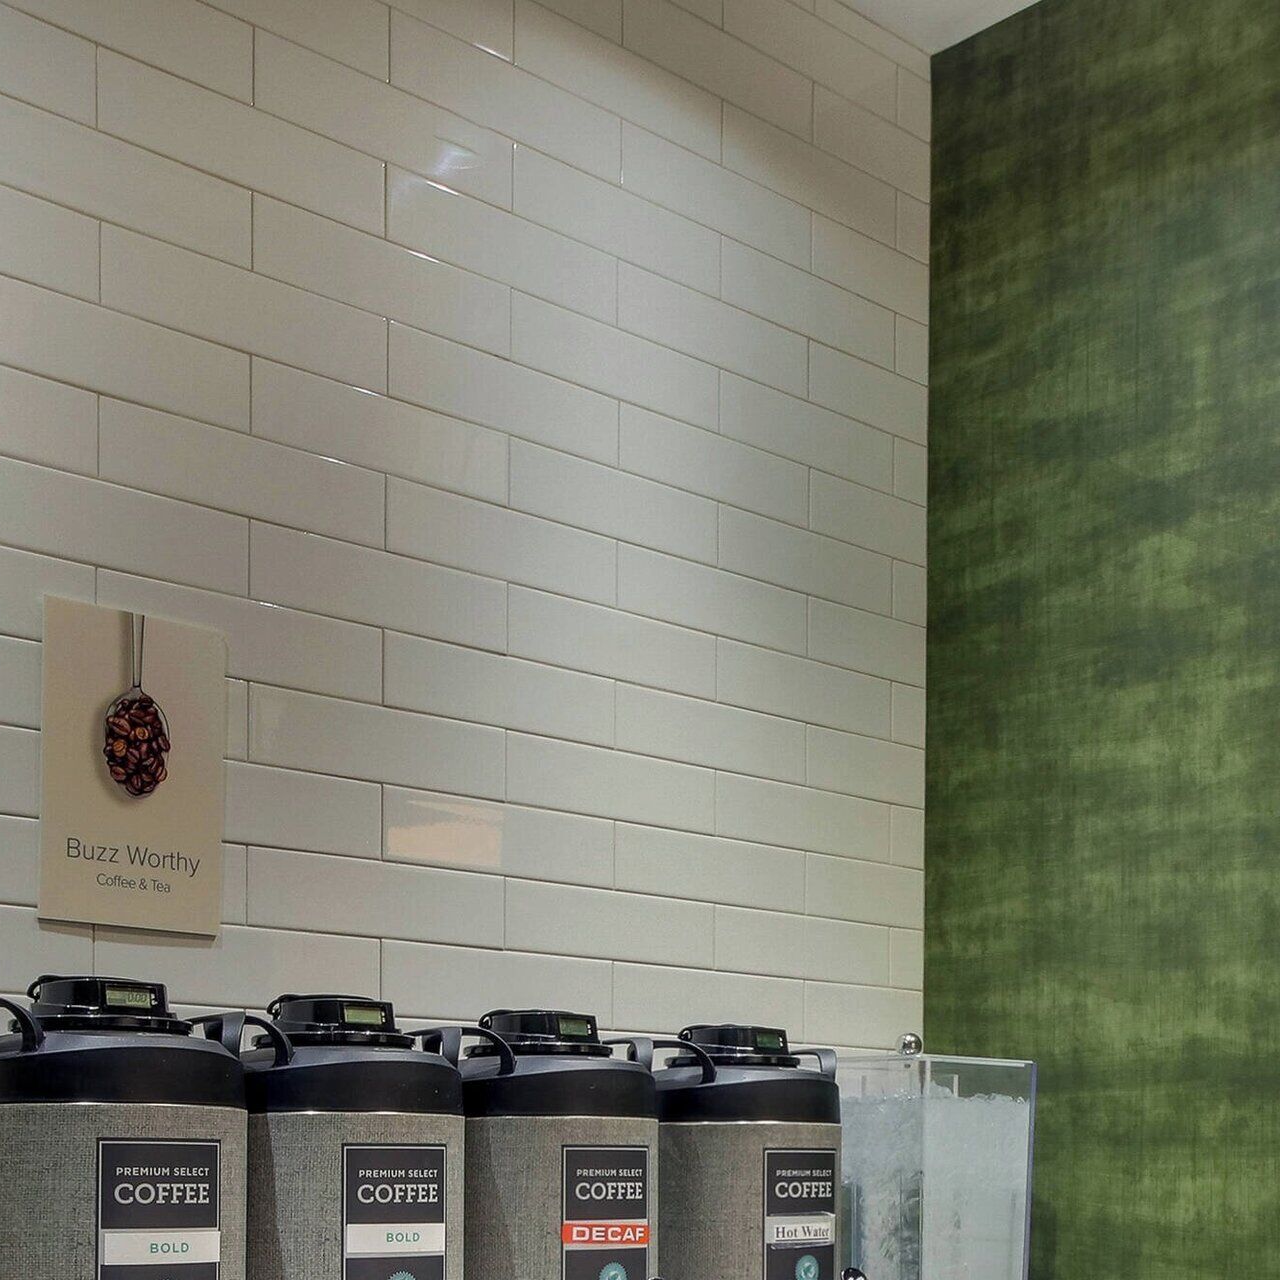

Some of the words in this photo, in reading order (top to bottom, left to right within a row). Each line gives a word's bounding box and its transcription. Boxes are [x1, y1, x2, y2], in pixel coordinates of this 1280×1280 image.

[67, 838, 119, 863] Buzz
[126, 845, 200, 877] Worthy
[96, 873, 137, 890] Coffee
[139, 878, 148, 891] &
[150, 879, 171, 893] Tea
[116, 1167, 170, 1176] PREMIUM
[173, 1167, 209, 1176] SELECT
[358, 1169, 406, 1178] PREMIUM
[408, 1169, 438, 1178] SELECT
[576, 1169, 617, 1177] PREMIUM
[619, 1168, 643, 1177] SELECT
[776, 1169, 811, 1177] PREMIUM
[812, 1169, 832, 1177] SELECT
[114, 1183, 209, 1204] COFFEE
[357, 1184, 438, 1203] COFFEE
[575, 1182, 643, 1200] COFFEE
[775, 1182, 832, 1198] COFFEE
[386, 1232, 420, 1243] BOLD
[572, 1226, 645, 1241] DECAF
[775, 1226, 798, 1239] Hot
[802, 1225, 830, 1239] Water
[150, 1242, 189, 1253] BOLD
